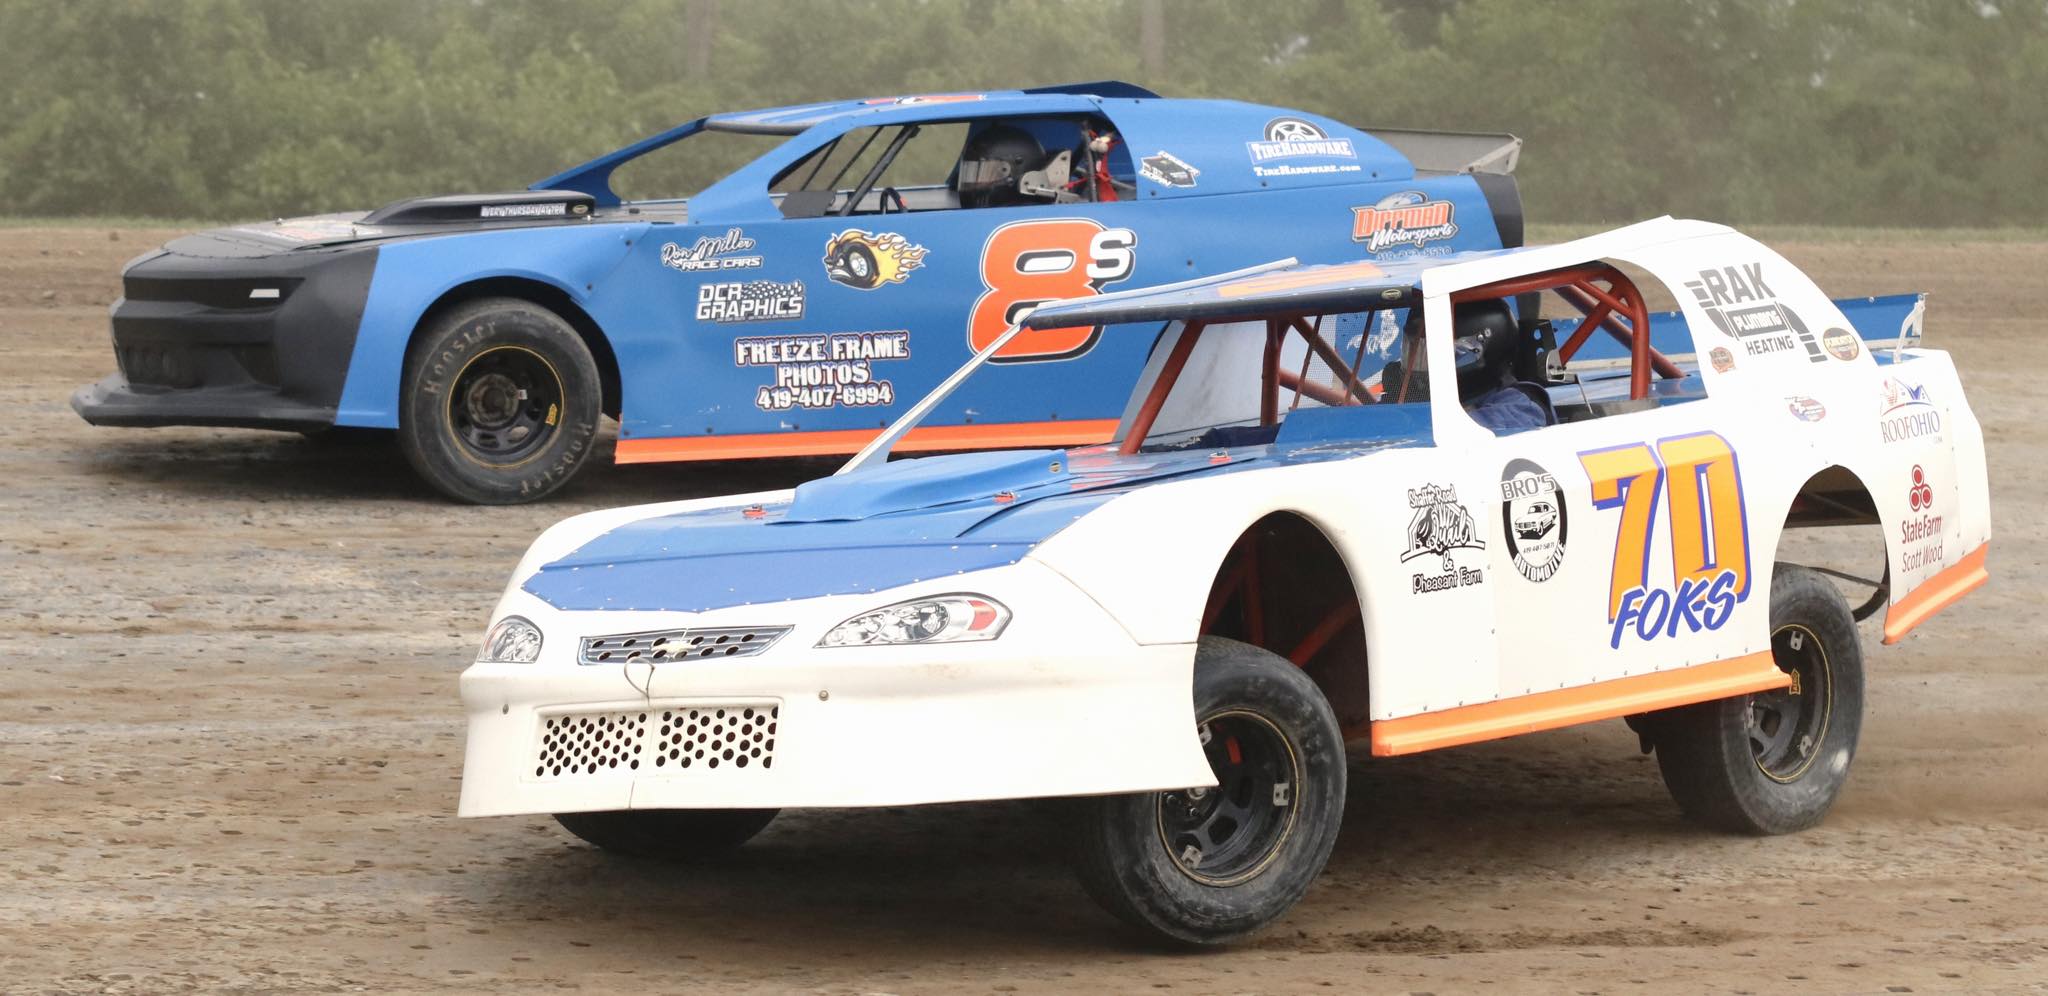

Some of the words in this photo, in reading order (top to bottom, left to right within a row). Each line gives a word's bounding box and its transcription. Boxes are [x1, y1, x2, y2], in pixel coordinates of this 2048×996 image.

[1250, 141, 1353, 160] TIREHARDWARE
[663, 243, 695, 266] Ron
[696, 229, 754, 260] Miller
[1369, 223, 1453, 251] Motorsports
[682, 259, 720, 271] RACE
[723, 257, 760, 269] CARS
[700, 284, 742, 301] DCR
[1699, 262, 1776, 306] RAK
[697, 297, 803, 320] GRAPHICS
[1733, 310, 1783, 331] PLUMBING
[737, 336, 826, 364] FREEZE
[831, 332, 907, 360] FRAME
[1745, 335, 1794, 356] HEATING
[777, 361, 870, 388] PHOTOS
[757, 382, 892, 408] 419-407-6994
[1880, 410, 1940, 444] ROOFOHIO
[1501, 474, 1557, 500] BRO'S
[1577, 430, 1751, 624] 70
[1443, 550, 1453, 571] &
[1514, 541, 1566, 582] AUTOMOTIVE
[1902, 547, 1921, 573] Scott
[1922, 538, 1943, 565] Wood
[1412, 571, 1458, 594] Pheasant
[1459, 566, 1482, 586] Farm
